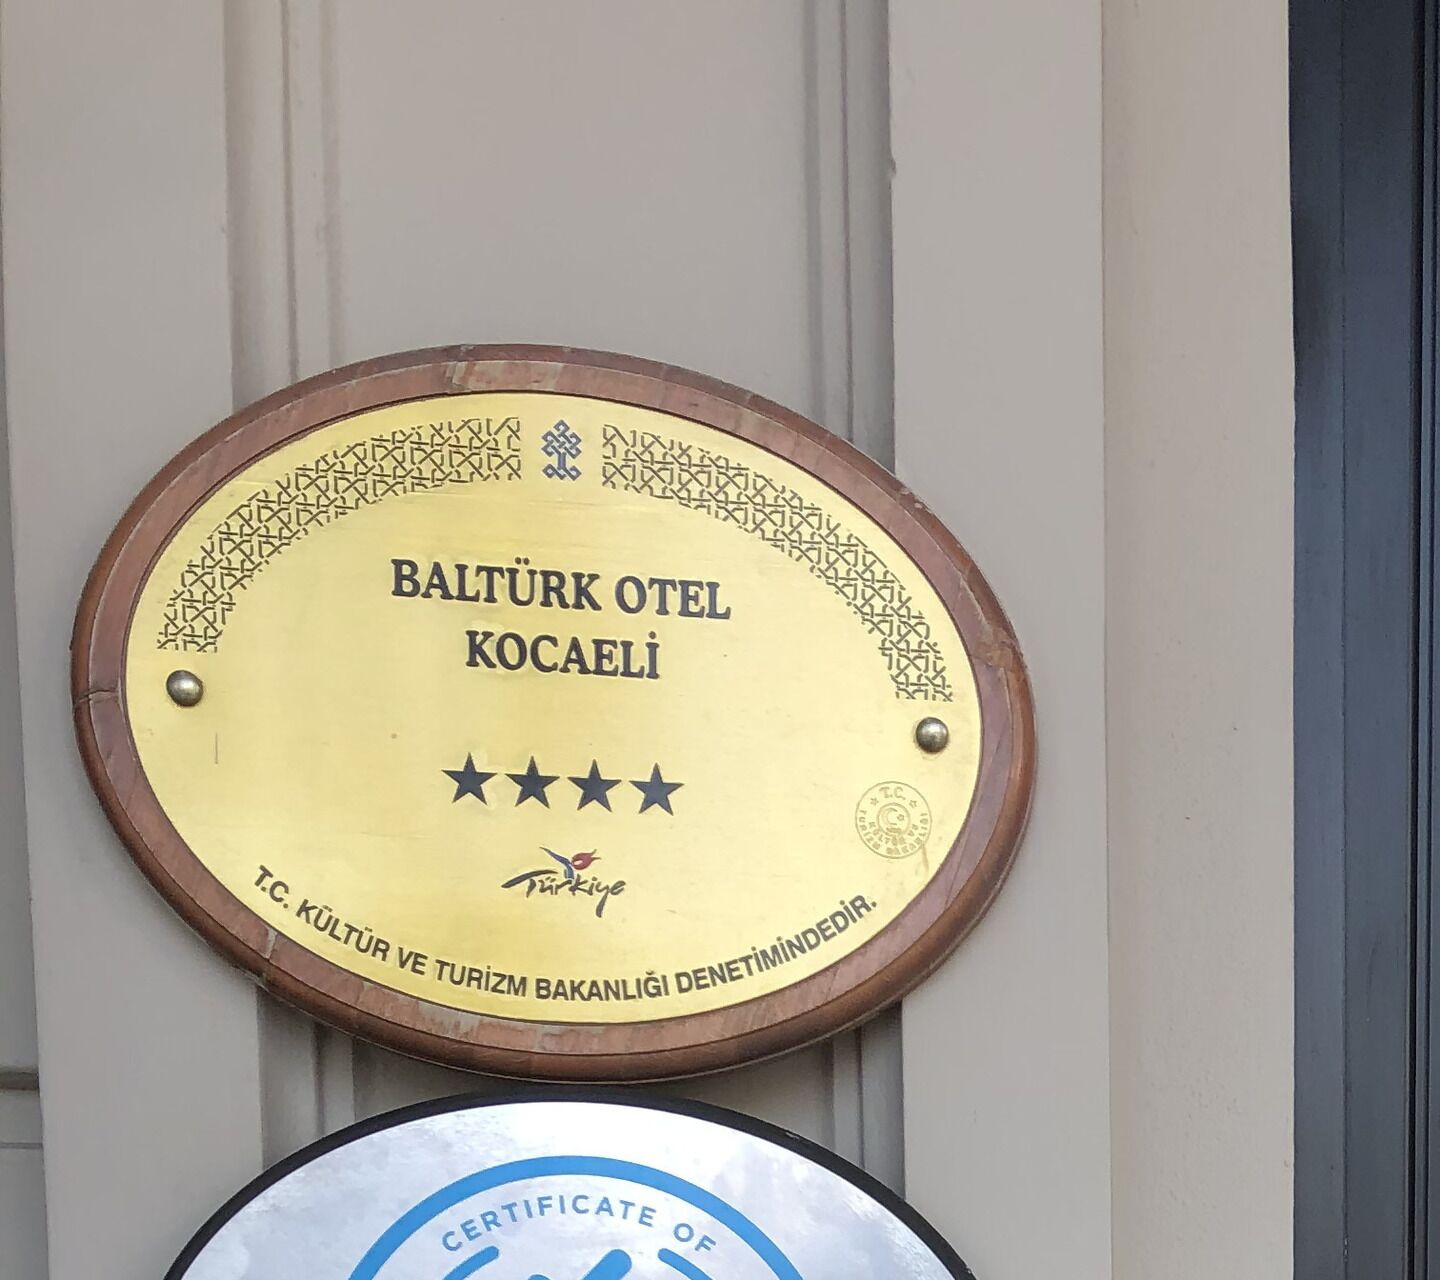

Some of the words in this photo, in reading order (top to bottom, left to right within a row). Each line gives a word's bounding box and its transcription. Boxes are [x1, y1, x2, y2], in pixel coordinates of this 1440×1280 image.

[391, 557, 602, 611] BALTÜRK
[615, 575, 731, 620] OTEL
[465, 630, 660, 680] KOCAELİ
[501, 869, 626, 918] Türkiye
[254, 865, 289, 909] T.C.
[296, 899, 391, 962] KÜLTÜR
[398, 947, 428, 976] VE
[435, 959, 527, 997] TURİZM
[535, 971, 669, 1002] BAKANLIĞI
[676, 894, 877, 995] DENETİMİNDEDİR.
[441, 1195, 657, 1251] CERTIFICATE
[673, 1222, 717, 1252] OF
